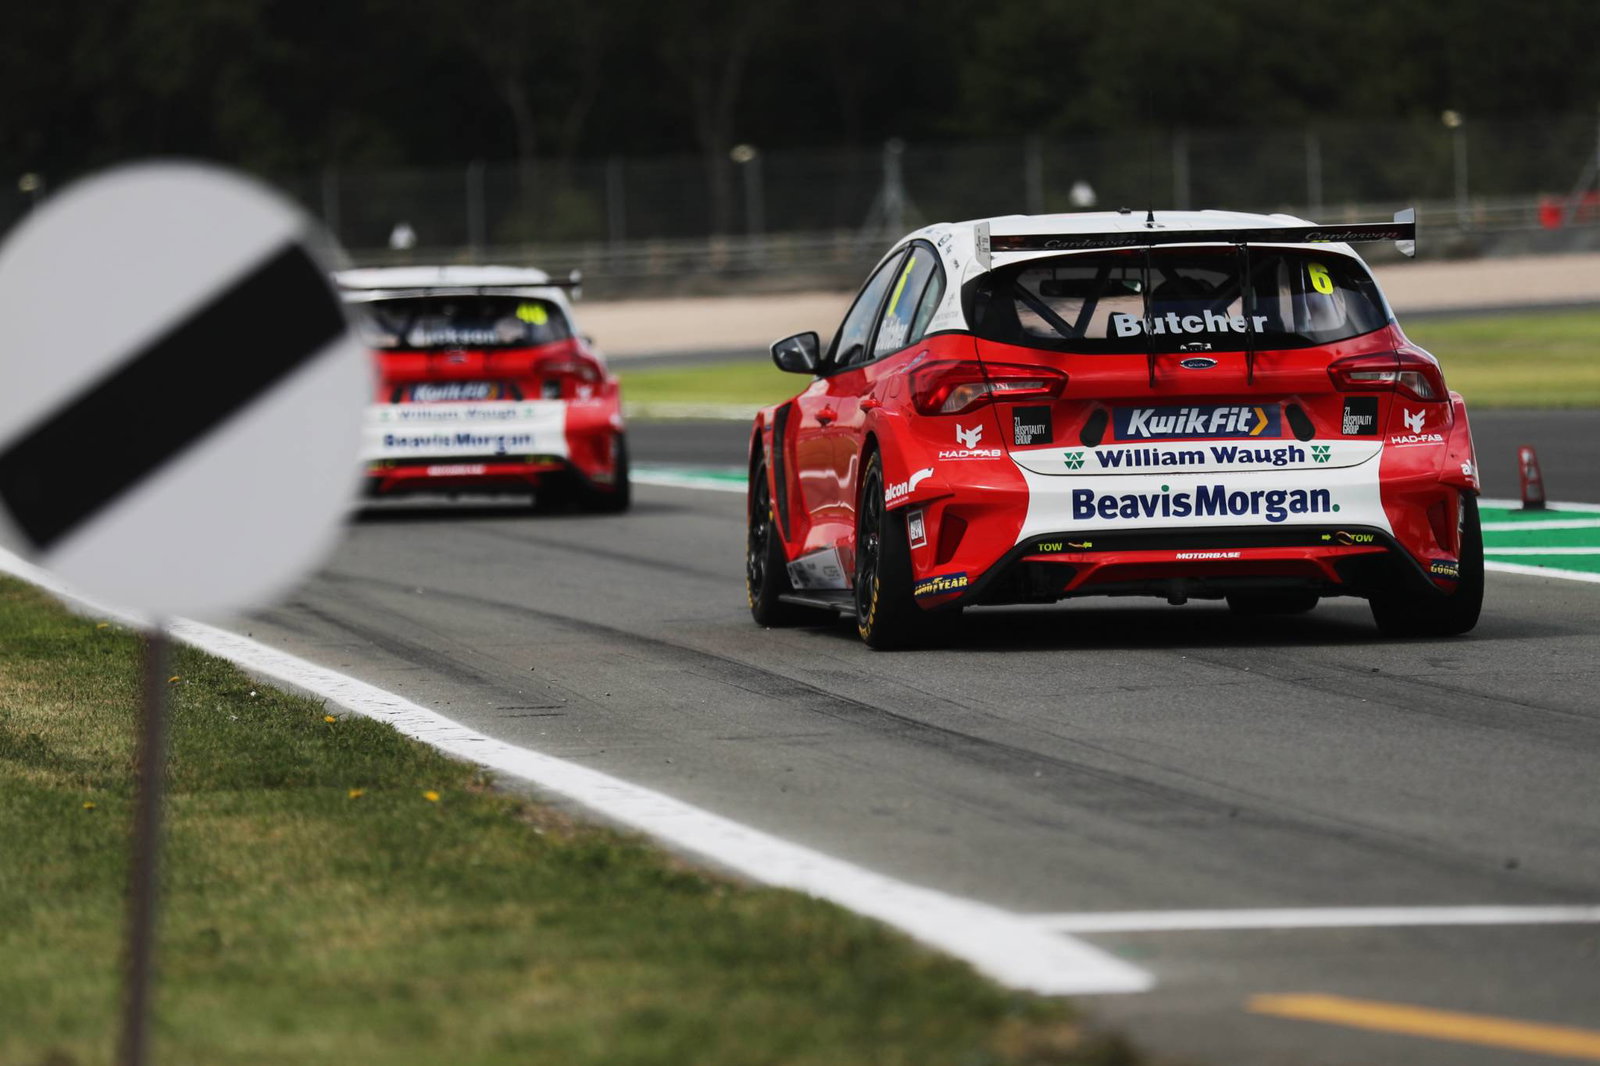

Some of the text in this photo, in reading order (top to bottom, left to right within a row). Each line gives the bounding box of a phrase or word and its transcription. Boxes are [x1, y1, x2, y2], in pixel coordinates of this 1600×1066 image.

[1307, 263, 1334, 295] 6
[1113, 309, 1268, 338] Butcher
[1126, 407, 1252, 437] KwikFit
[1344, 415, 1373, 425] HOSPITALITY
[1014, 424, 1046, 435] HOSPITALITY
[1343, 424, 1360, 434] GROUP
[1015, 434, 1033, 445] GROUP
[1391, 433, 1443, 444] HAD-FAB
[938, 449, 1001, 458] HAD-FAB
[1095, 445, 1305, 468] William Waugh
[885, 482, 908, 502] alcon
[1350, 534, 1374, 542] TOW
[1038, 543, 1063, 551] TOW
[914, 576, 968, 596] GOODYEAR
